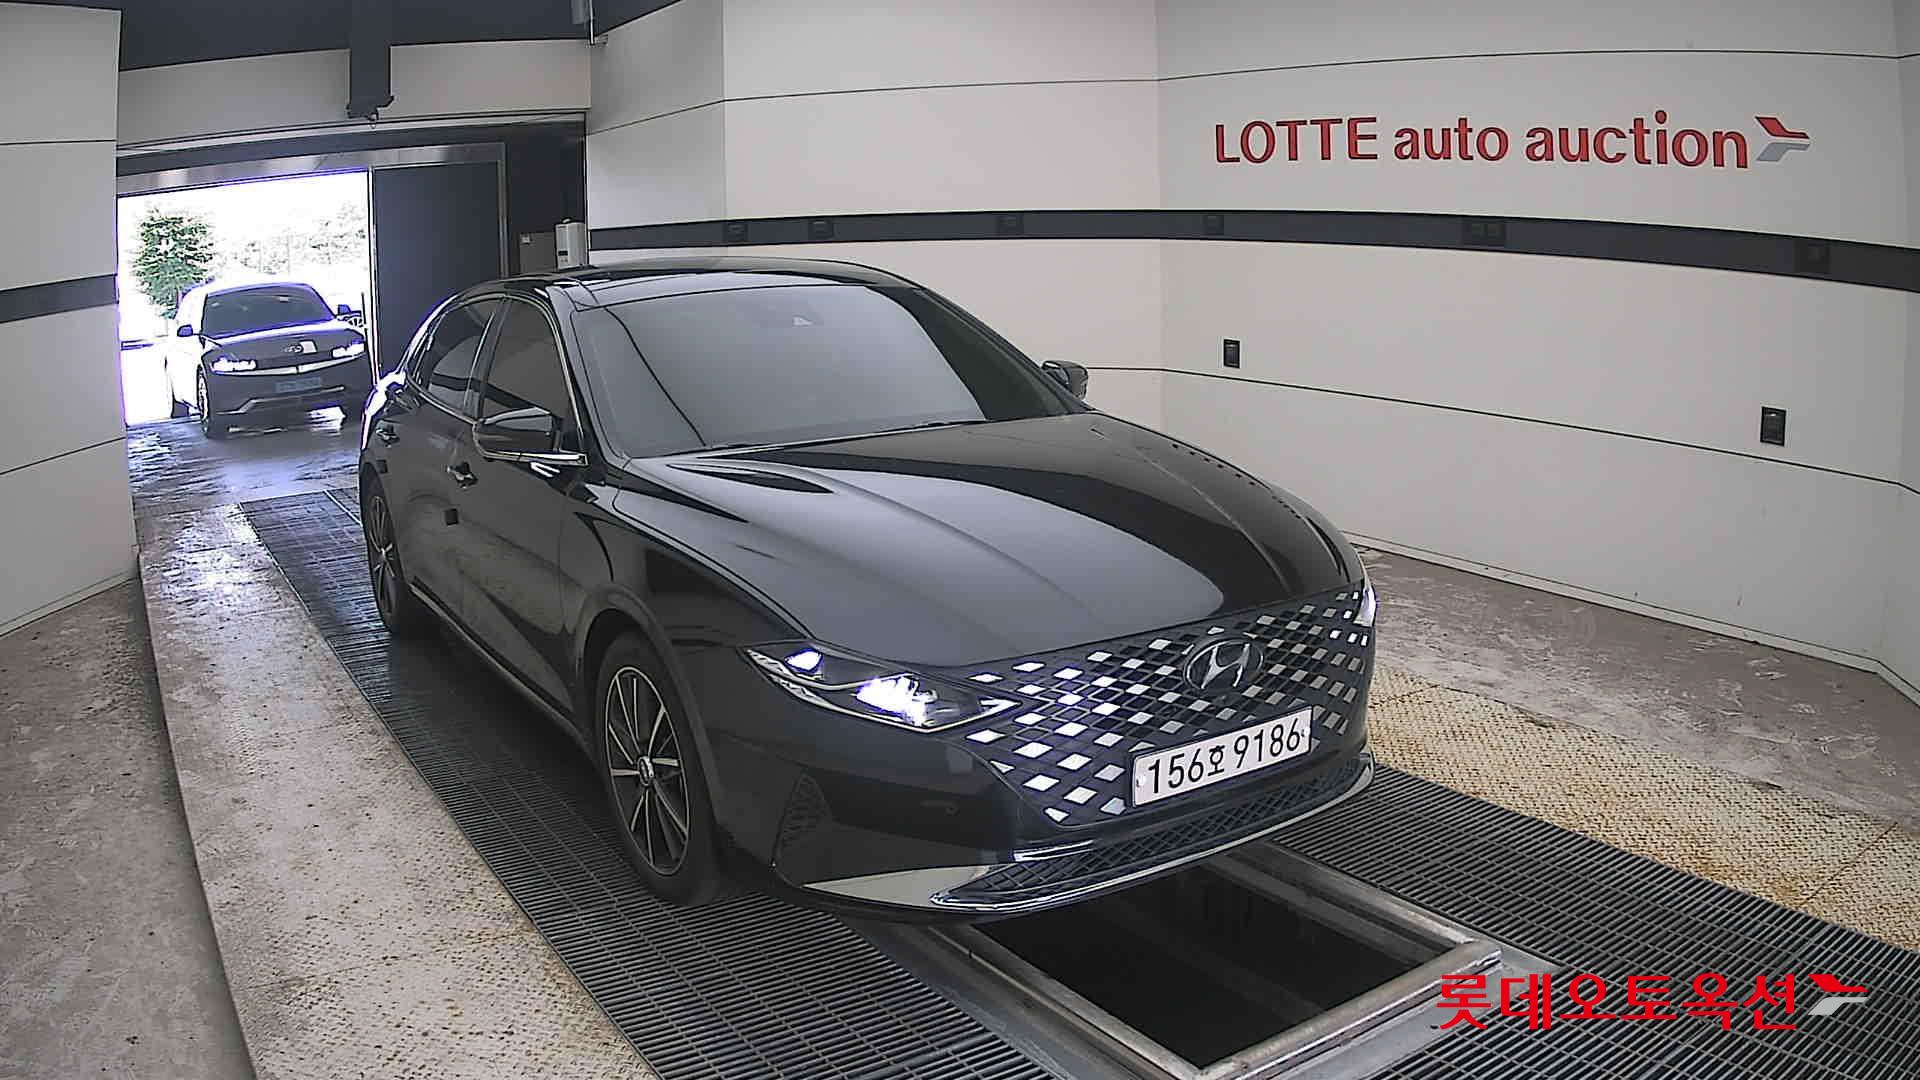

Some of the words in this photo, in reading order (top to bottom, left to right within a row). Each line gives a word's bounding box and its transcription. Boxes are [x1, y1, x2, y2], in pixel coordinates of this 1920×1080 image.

[1214, 116, 1378, 164] LOTTE
[1393, 117, 1509, 161] auto
[1525, 110, 1749, 168] auction
[1233, 717, 1301, 770] 9186
